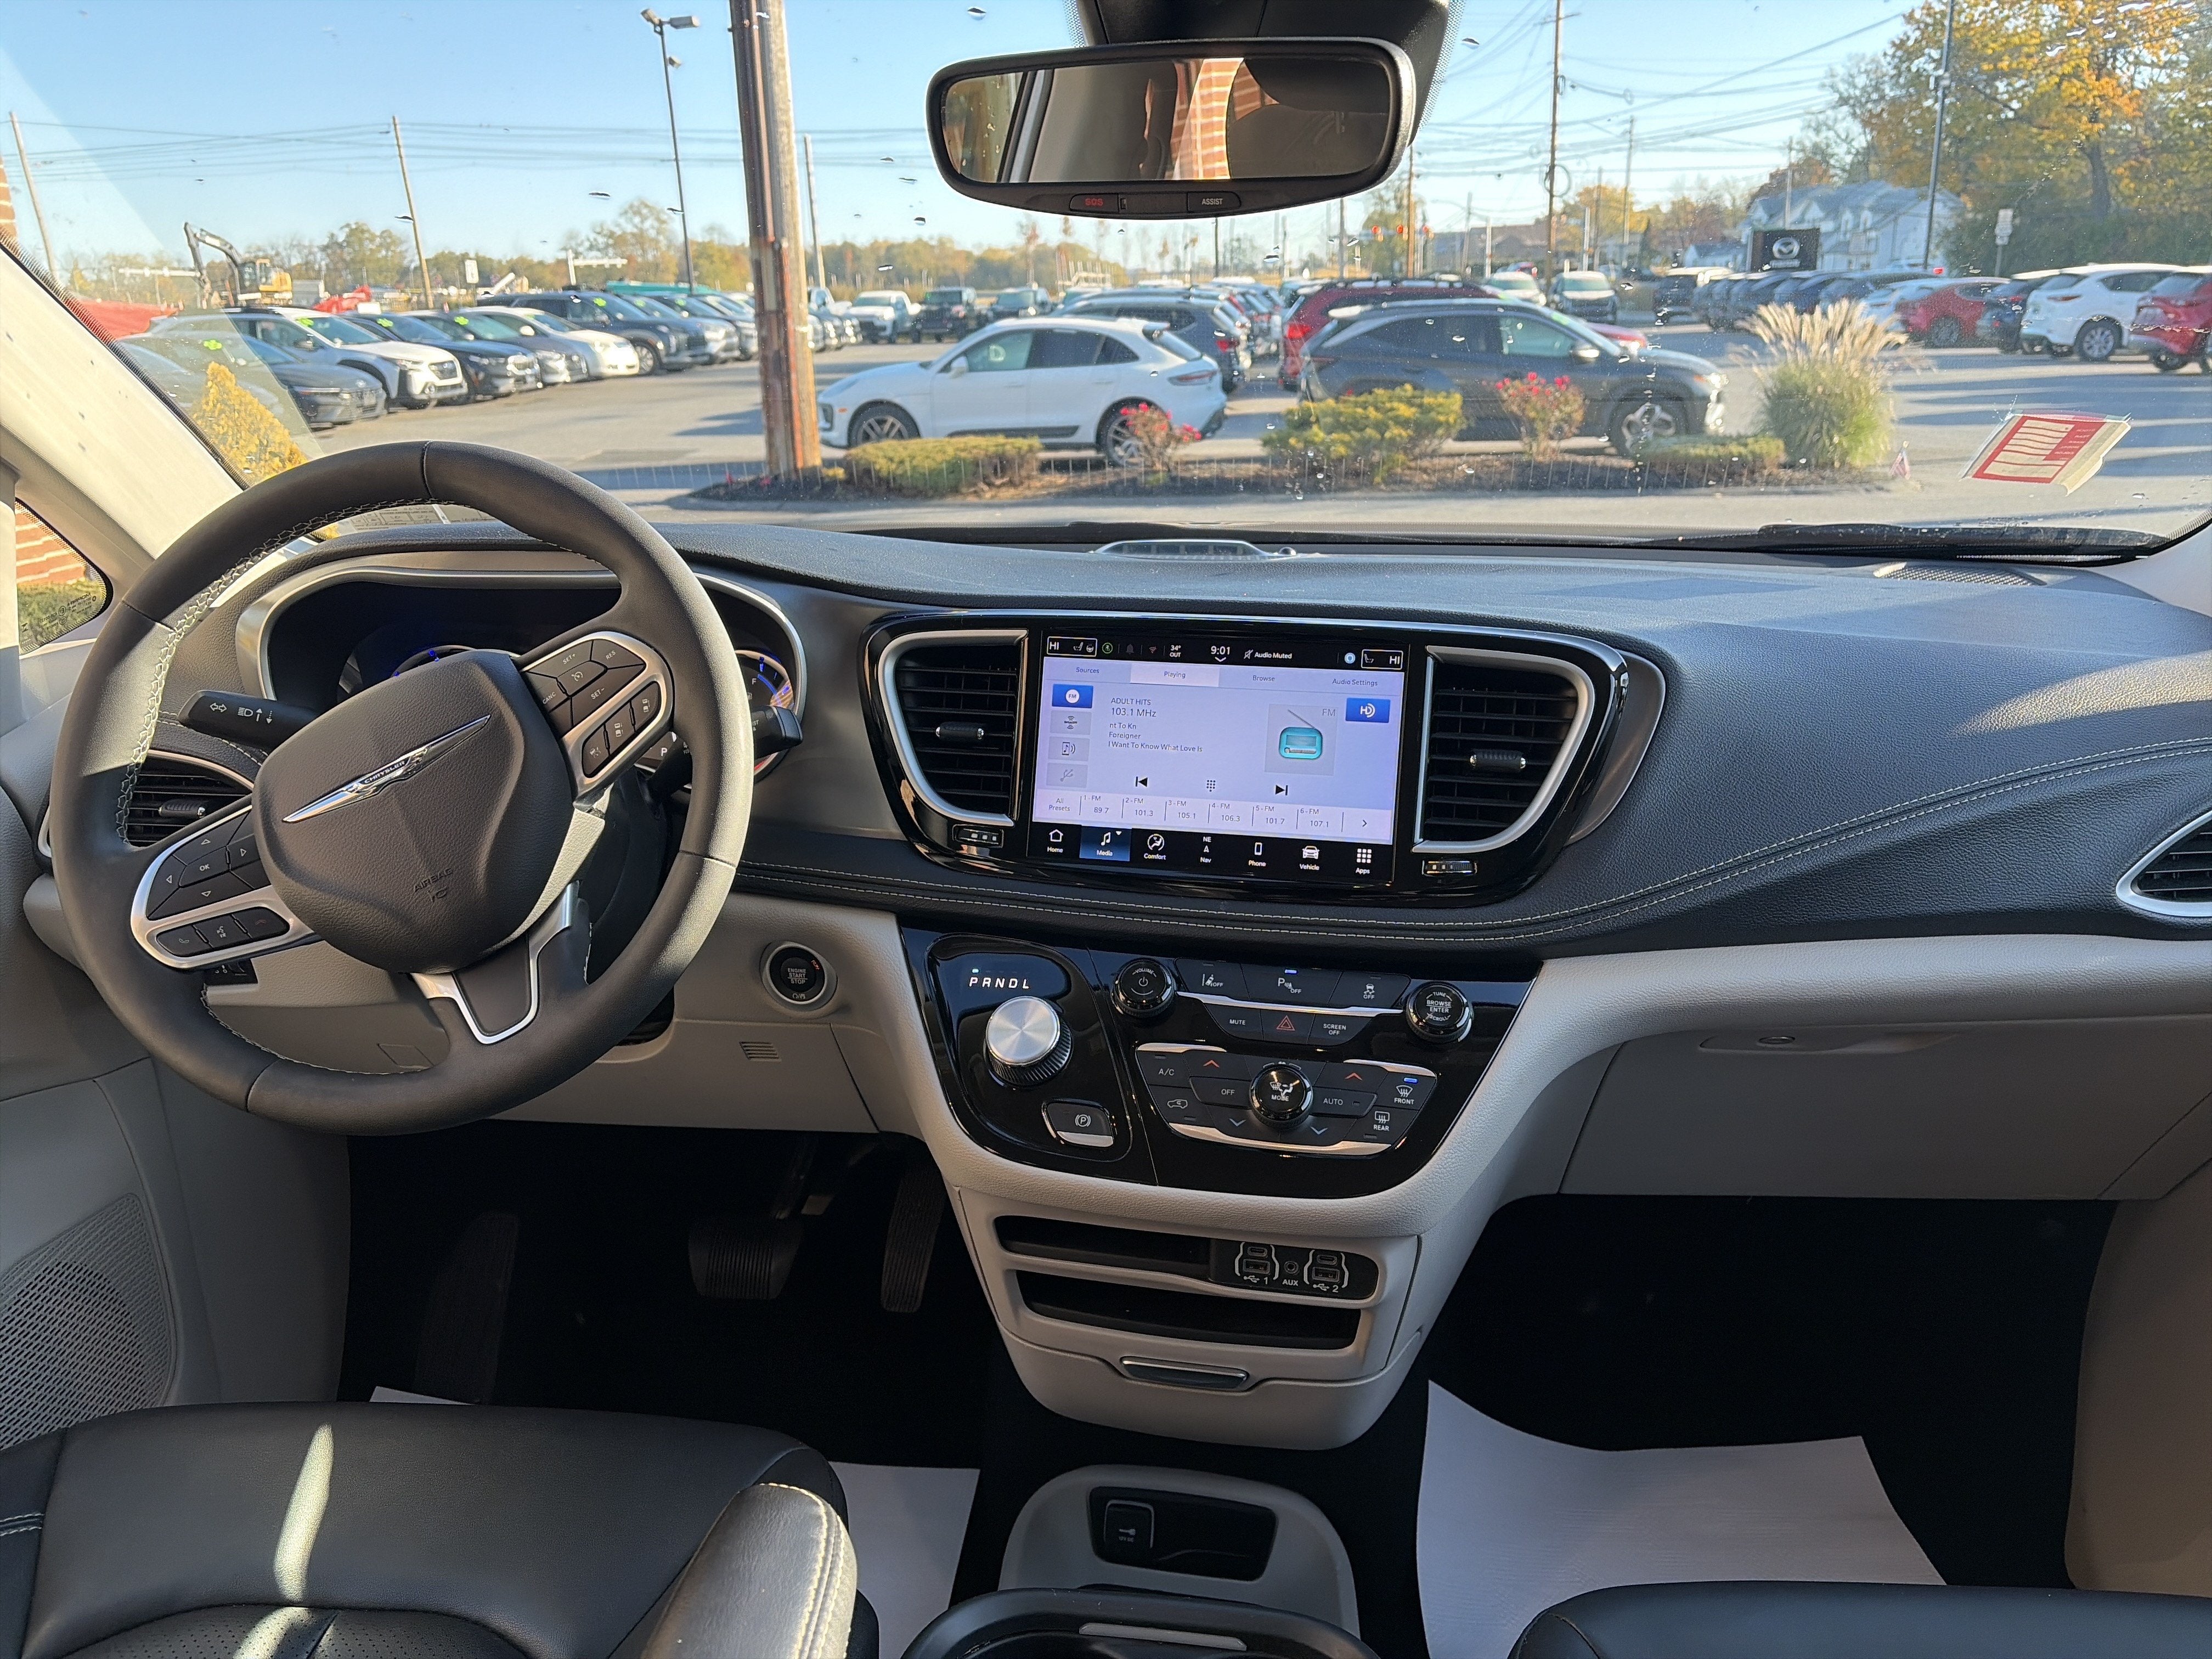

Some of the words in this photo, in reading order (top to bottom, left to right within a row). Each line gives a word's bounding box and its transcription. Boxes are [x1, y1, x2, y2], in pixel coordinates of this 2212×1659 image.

[606, 650, 616, 659] RES
[1211, 646, 1230, 655] 9:01
[1389, 656, 1400, 664] HI
[1164, 671, 1186, 679] Playing
[542, 692, 556, 704] CANC
[1111, 708, 1133, 716] 103.1
[1137, 709, 1156, 717] MHz
[1322, 708, 1336, 716] FM
[1109, 731, 1141, 740] Foreigner
[414, 868, 453, 893] AIRBAG
[1158, 1066, 1175, 1076] A/C
